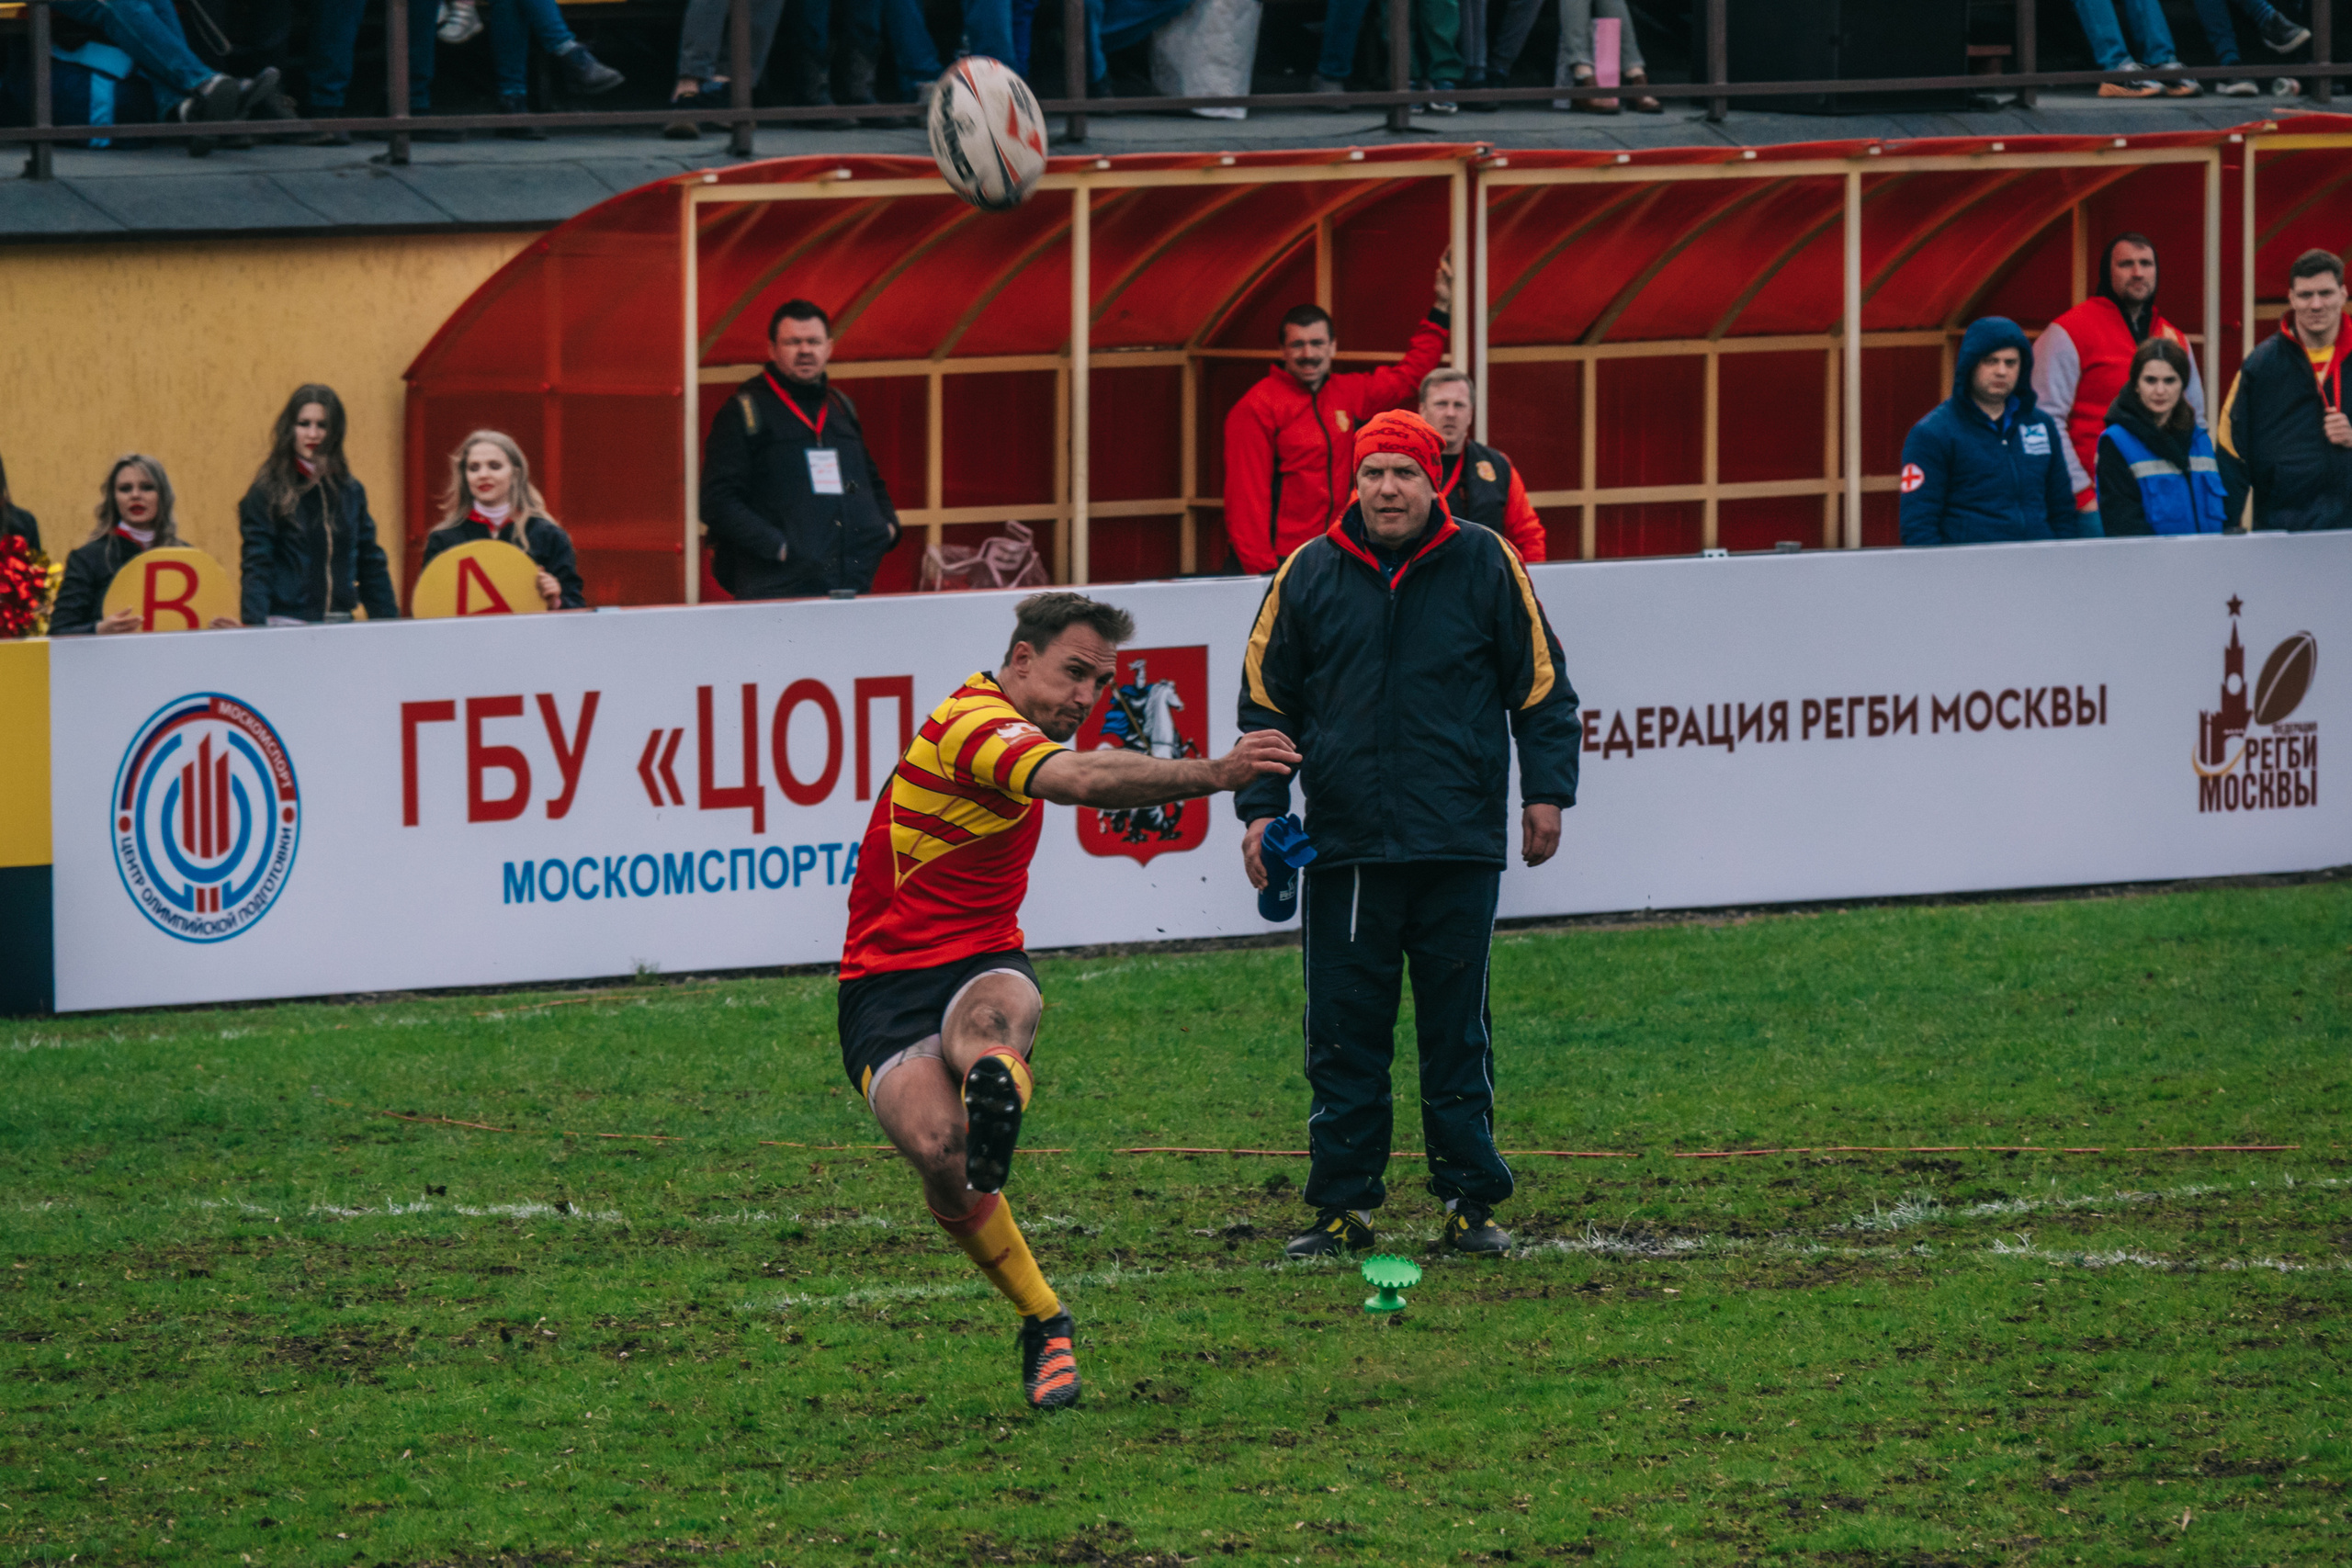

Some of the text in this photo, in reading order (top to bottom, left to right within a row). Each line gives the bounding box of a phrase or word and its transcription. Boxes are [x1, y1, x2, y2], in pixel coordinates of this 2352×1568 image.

[217, 701, 293, 789] МОСКОМСПОРТ
[401, 690, 601, 827] ГБУ
[1582, 683, 2108, 761] ЕДЕРАЦИЯ РЕГБИ МОСКВЫ
[2245, 735, 2318, 772] РЕГБИ
[2199, 770, 2318, 813] МОСКВЫ
[120, 826, 293, 935] ЦЕНТР ОЛИМПИЙСКОЙ ПОДГОТОВКИ
